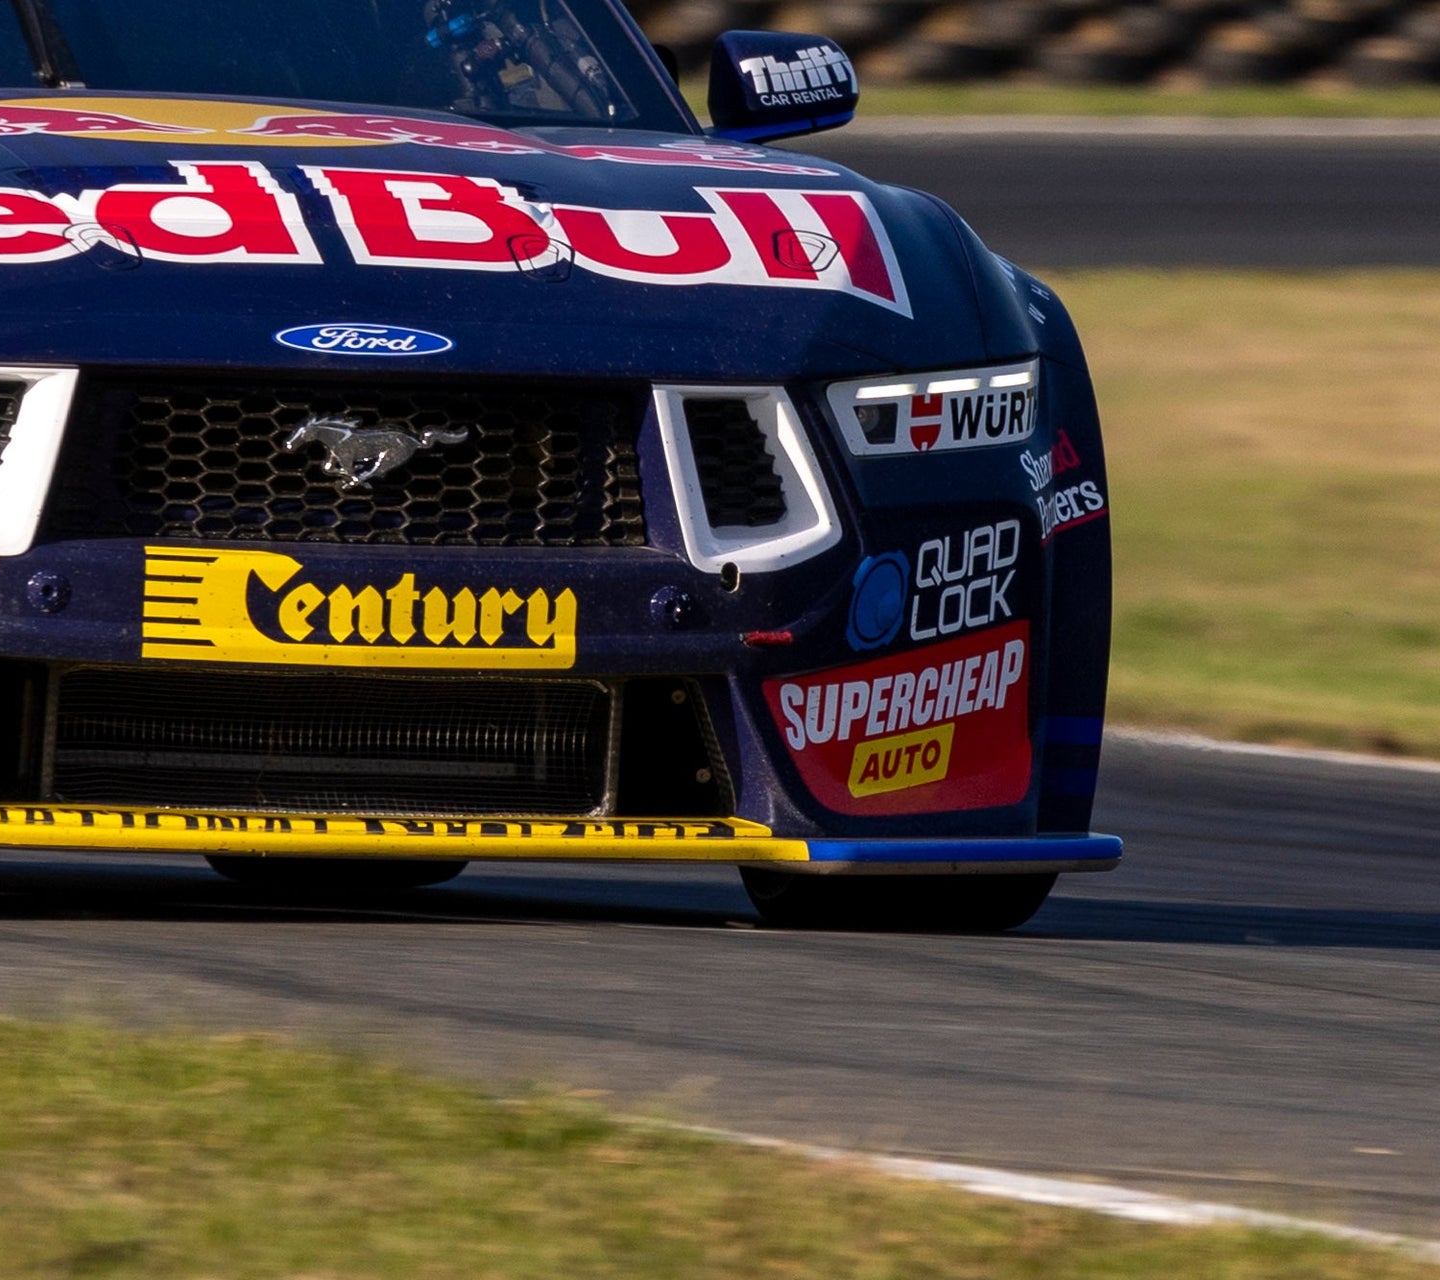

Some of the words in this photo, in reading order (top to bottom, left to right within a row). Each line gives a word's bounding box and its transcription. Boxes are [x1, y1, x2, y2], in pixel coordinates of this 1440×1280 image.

[739, 45, 859, 94] Thrifty
[760, 93, 791, 106] CAR
[793, 88, 843, 104] RENTAL
[301, 164, 913, 319] Bull
[311, 327, 418, 353] Ford
[949, 387, 1038, 441] WÜRT
[916, 520, 1020, 589] QUAD
[142, 545, 577, 669] Century
[910, 570, 1016, 640] LOCK
[779, 639, 1025, 751] SUPERCHEAP
[858, 739, 942, 784] AUTO
